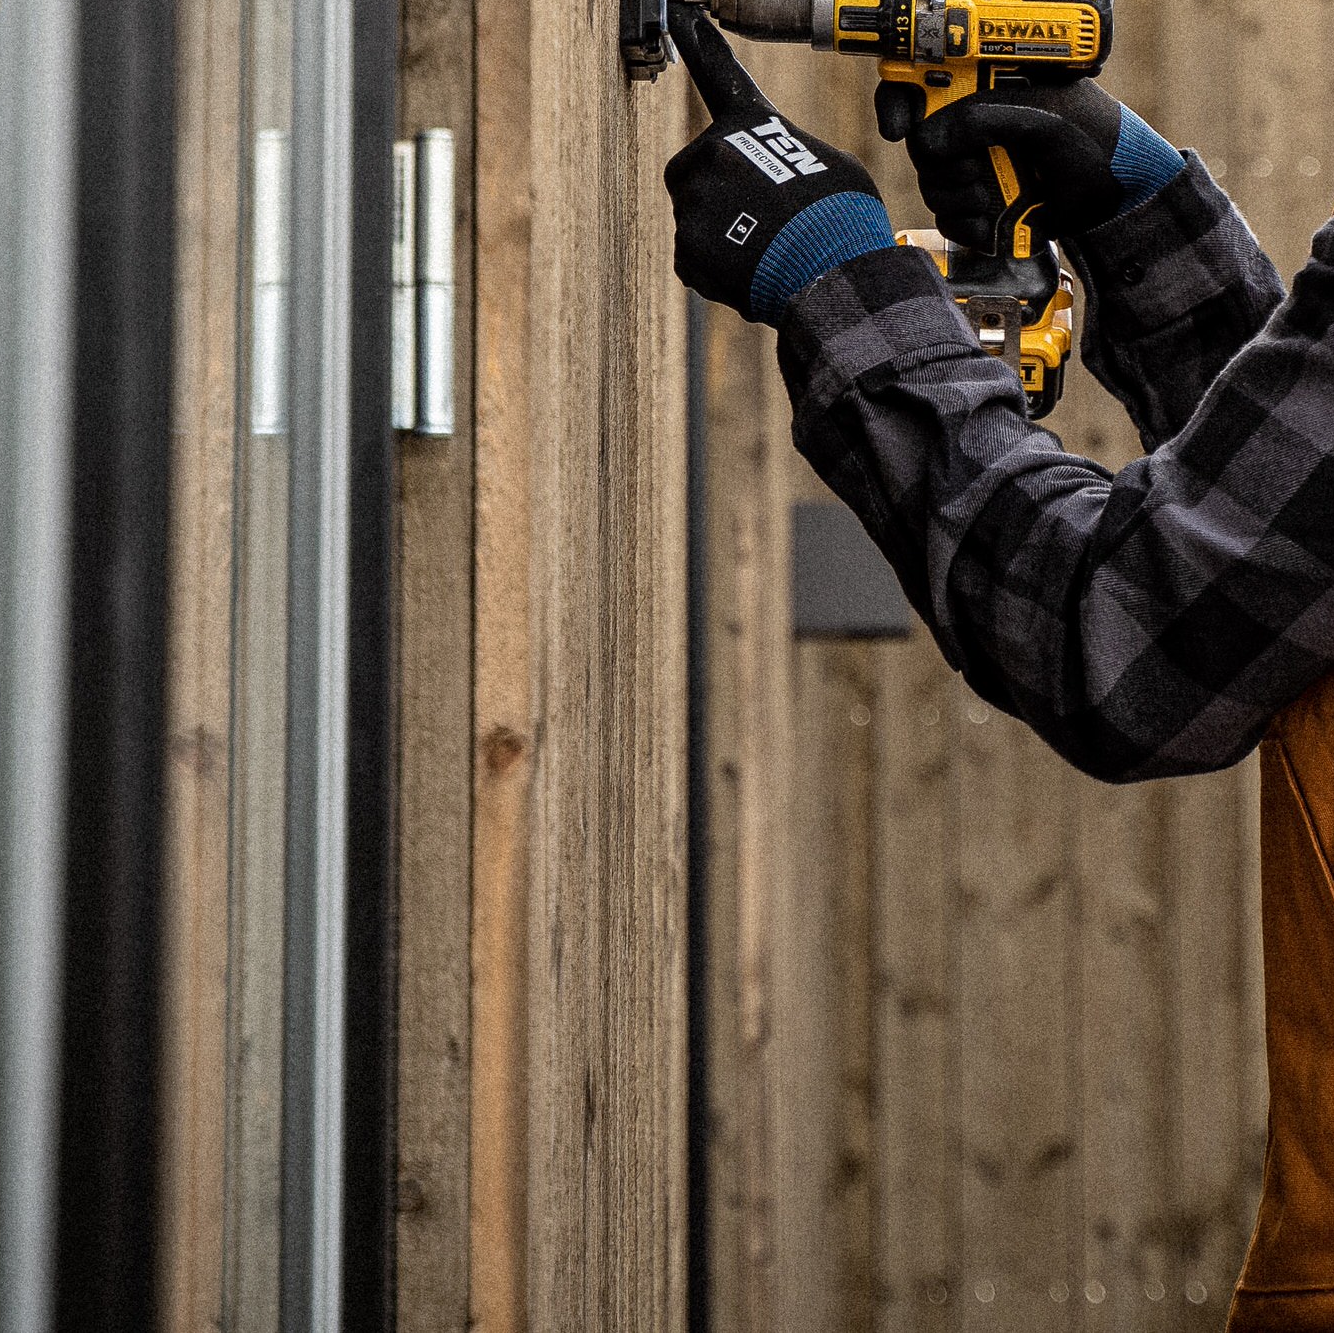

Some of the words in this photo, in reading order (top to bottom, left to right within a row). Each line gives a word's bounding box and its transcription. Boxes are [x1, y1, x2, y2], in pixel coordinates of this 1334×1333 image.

[896, 16, 909, 33] 13
[978, 20, 1070, 39] DEWALT
[751, 116, 828, 176] TEN
[735, 135, 785, 177] PROTECTION
[736, 224, 747, 234] 8
